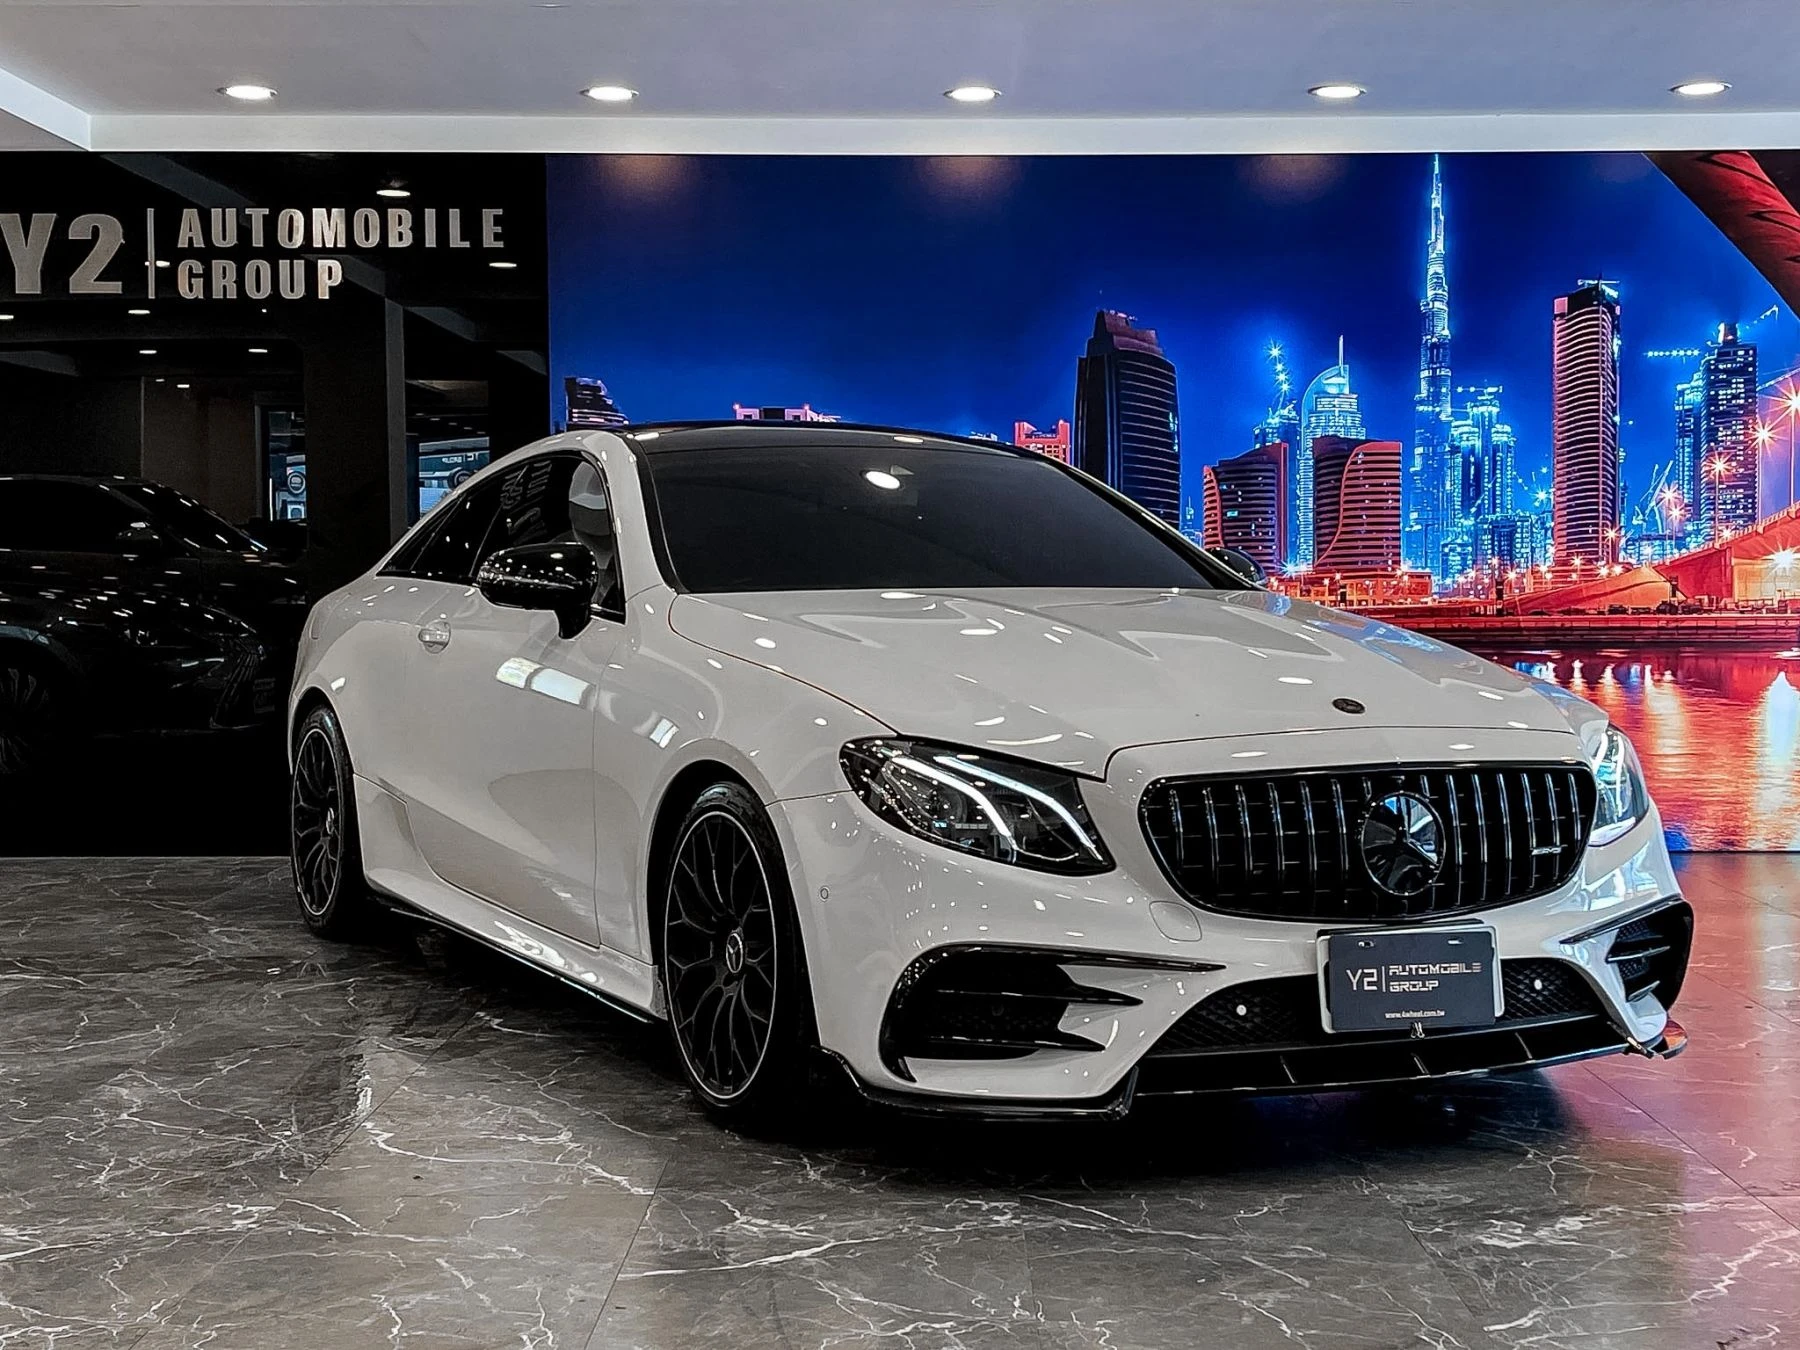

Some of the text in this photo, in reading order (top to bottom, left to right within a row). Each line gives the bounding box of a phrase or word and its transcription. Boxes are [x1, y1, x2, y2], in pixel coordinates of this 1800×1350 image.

[177, 208, 505, 249] AUTOMOBILE
[0, 212, 126, 295] Y2
[177, 259, 343, 300] GROUP
[1346, 968, 1378, 992] Y2
[1389, 962, 1483, 977] AUTOMOBILE
[1389, 980, 1440, 993] GROUP
